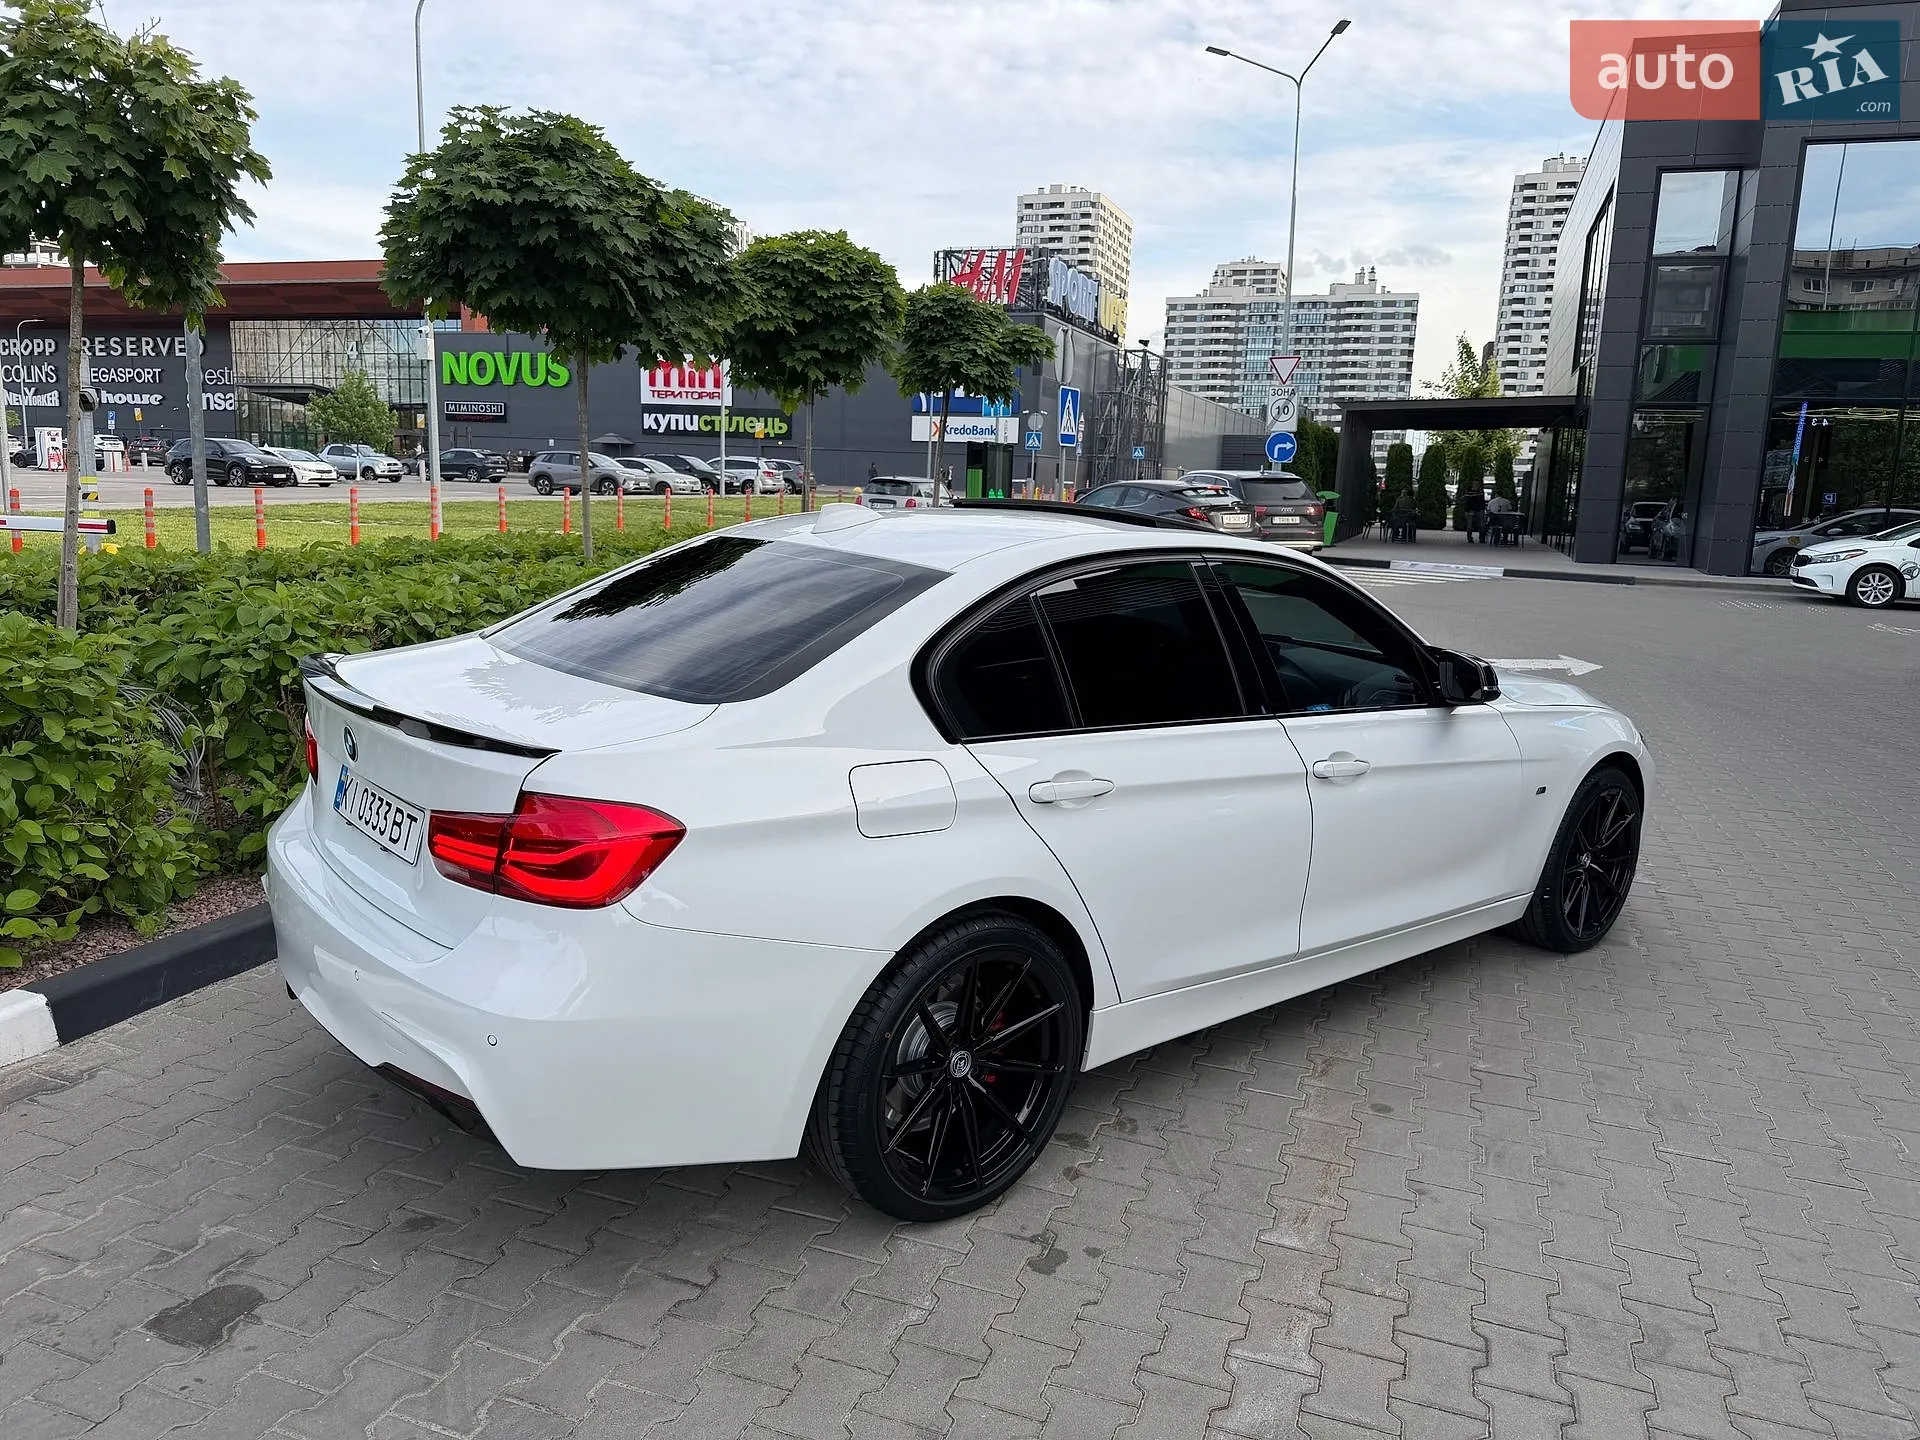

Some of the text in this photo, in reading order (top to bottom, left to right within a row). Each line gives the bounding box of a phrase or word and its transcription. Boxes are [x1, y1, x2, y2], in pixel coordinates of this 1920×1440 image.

[0, 338, 56, 356] CROPP
[2, 361, 57, 383] COLIN'S
[90, 366, 162, 383] EGASPORT
[442, 351, 570, 387] NOVUS
[101, 389, 164, 405] house
[649, 389, 721, 400] ТЕРИТОРІЯ
[1270, 387, 1297, 397] ЗОНА
[447, 403, 501, 414] MIMINOSHI
[1274, 404, 1290, 416] 10
[943, 423, 997, 437] KredoBank
[341, 775, 418, 851] KI 0333 BT
